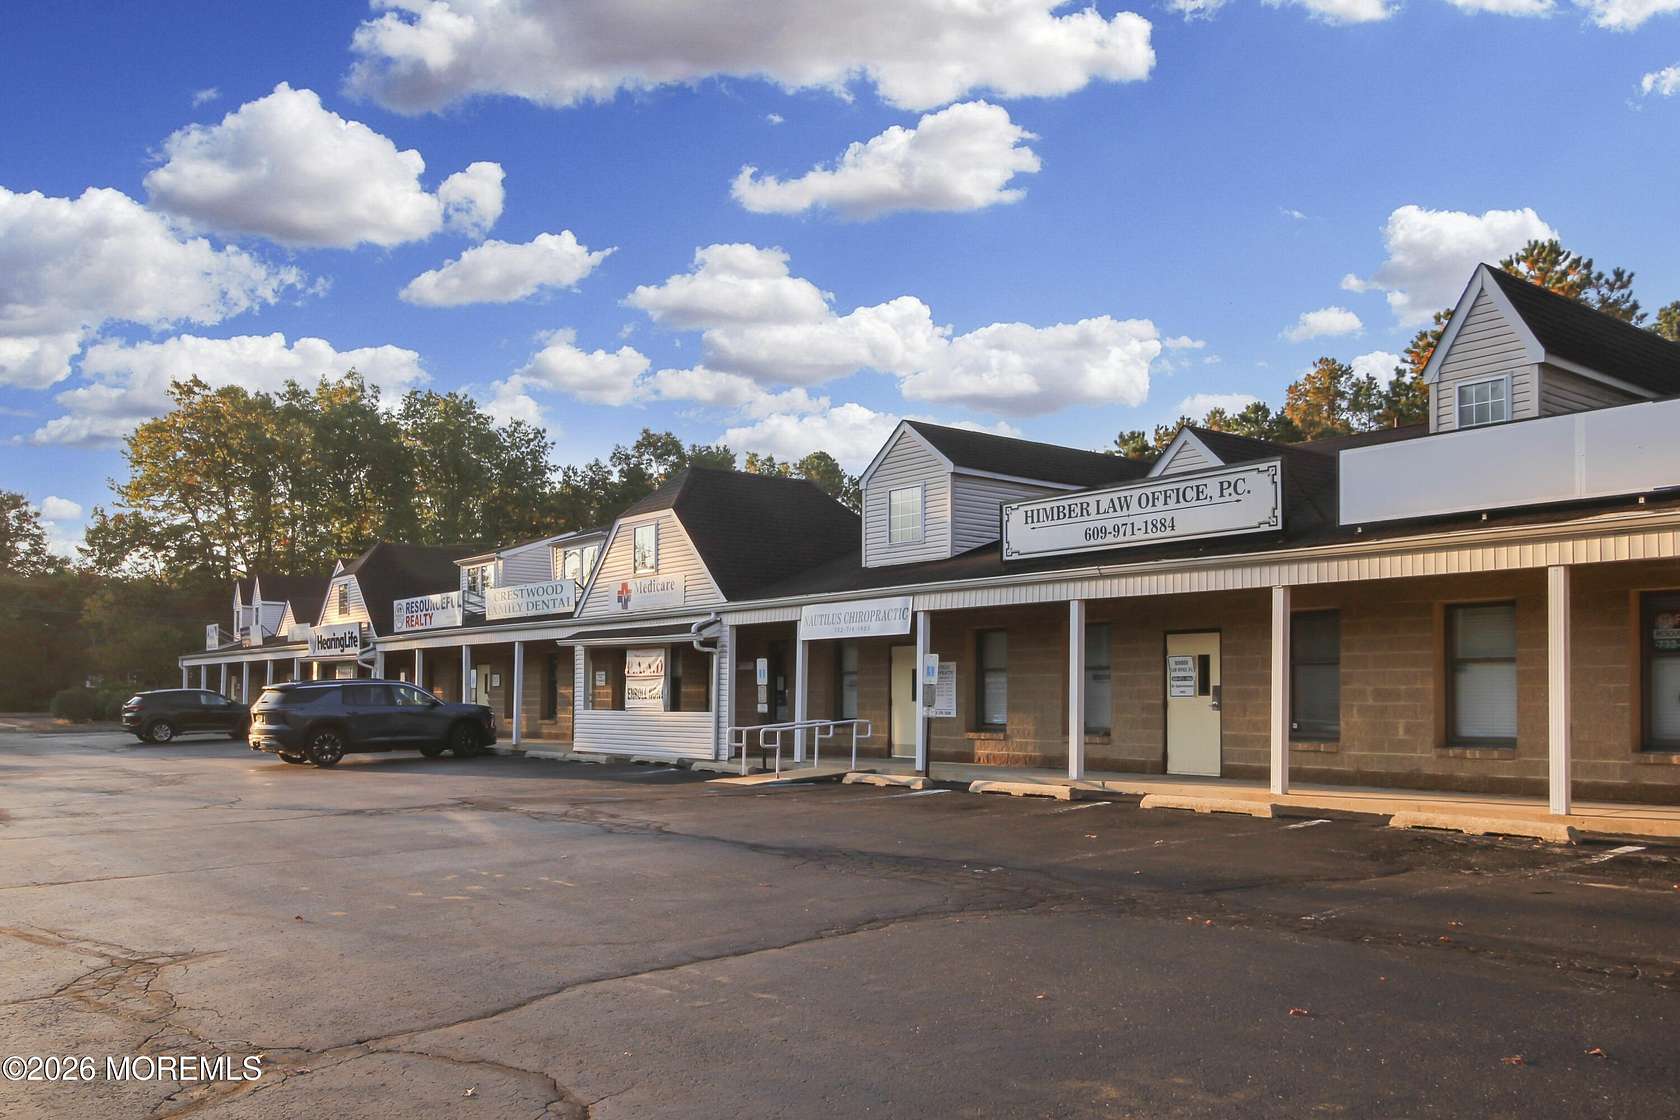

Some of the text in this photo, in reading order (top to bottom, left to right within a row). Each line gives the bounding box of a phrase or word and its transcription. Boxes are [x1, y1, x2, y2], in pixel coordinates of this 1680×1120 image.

[1024, 477, 1251, 525] HIMBER LAW OFFICE, P.C.
[1084, 516, 1176, 542] 609-971-1884
[635, 579, 675, 594] Medicare
[526, 597, 573, 612] DENTAL
[405, 612, 434, 629] REALTY
[804, 607, 909, 627] NAUTILUS CHIROPRACTIC
[317, 630, 358, 652] HearingLife
